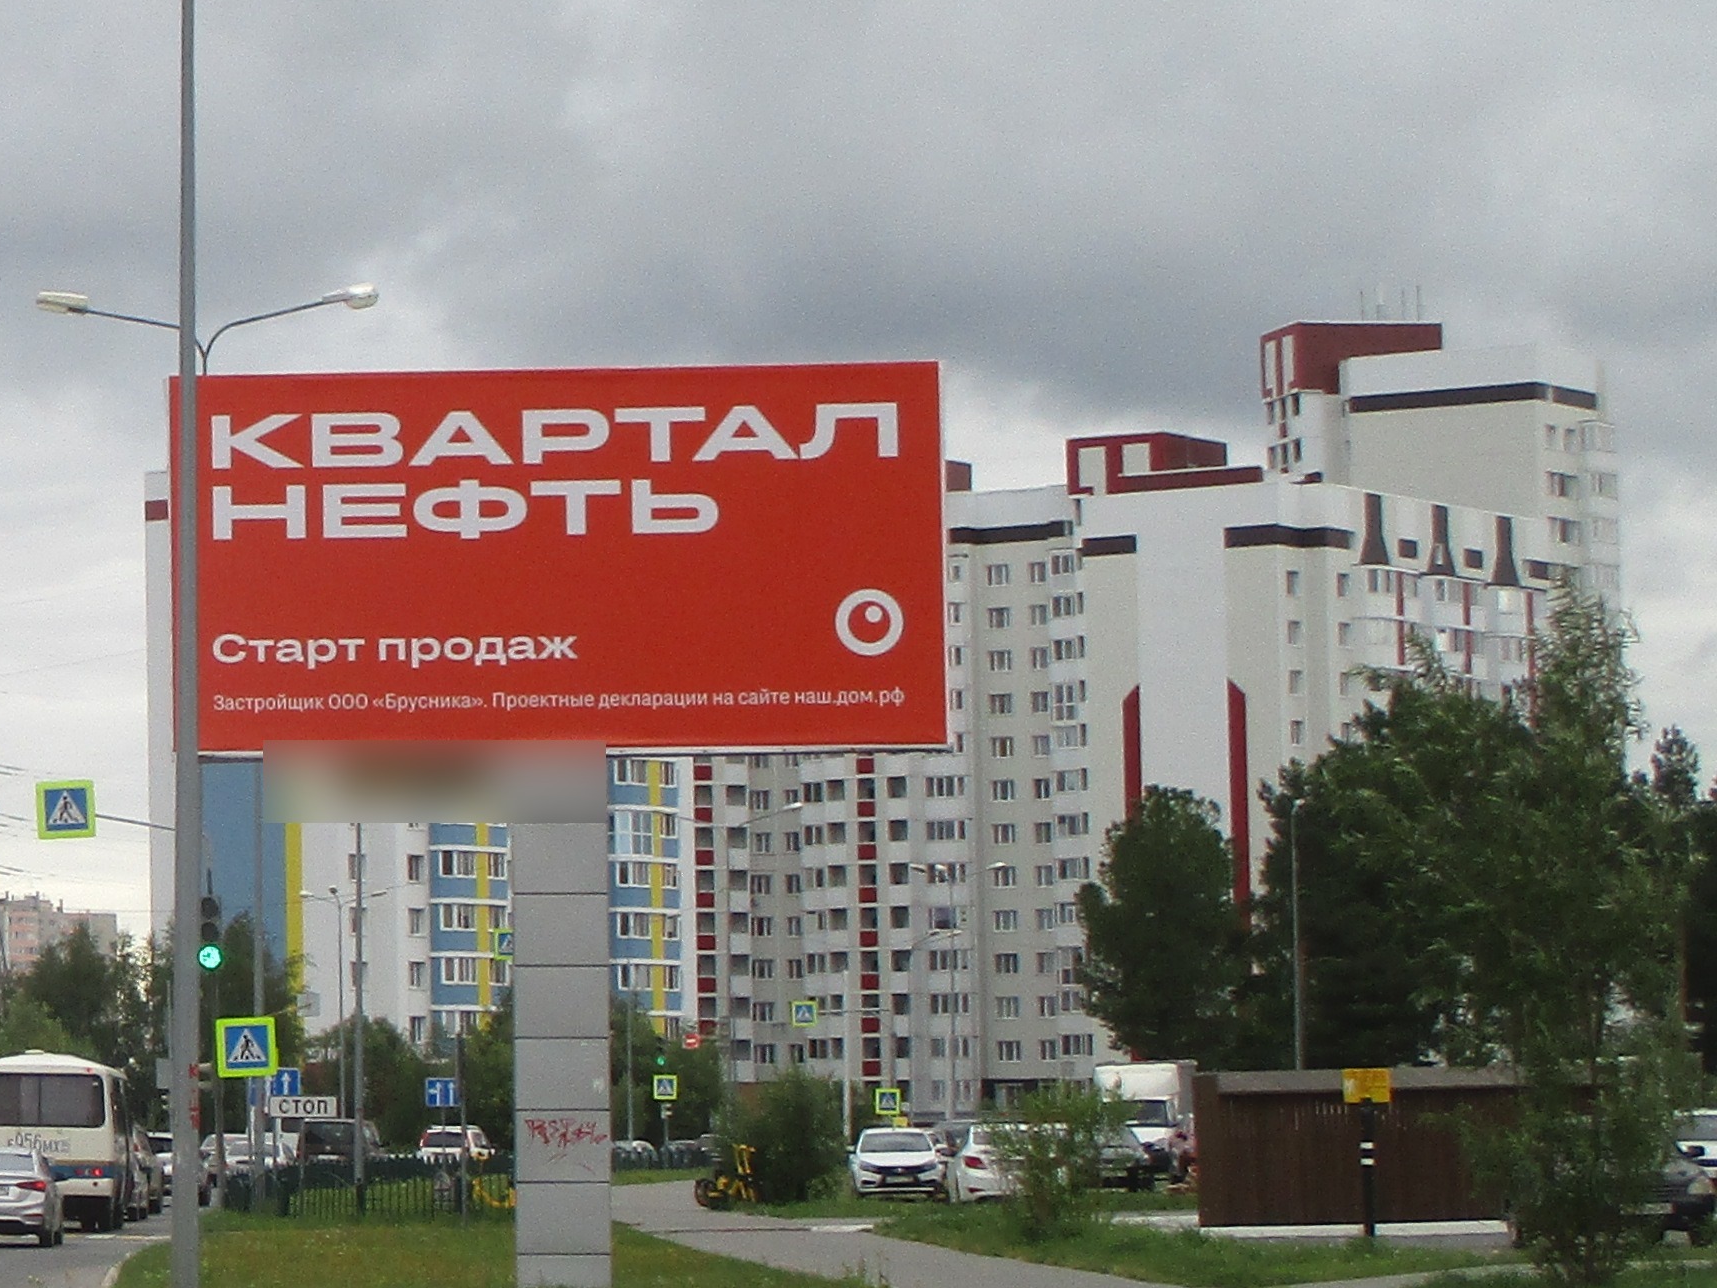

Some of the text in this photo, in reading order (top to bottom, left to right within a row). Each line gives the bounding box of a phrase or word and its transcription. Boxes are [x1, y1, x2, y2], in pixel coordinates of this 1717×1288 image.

[211, 402, 899, 470] КВАРТАЛ
[212, 479, 719, 541] НЕФТЬ
[212, 633, 578, 669] Старт продаж
[213, 686, 905, 713] Застройщик ООО «Брусника». Проектные декларации на сайте наш.дом.рф
[279, 1099, 327, 1114] СТОП
